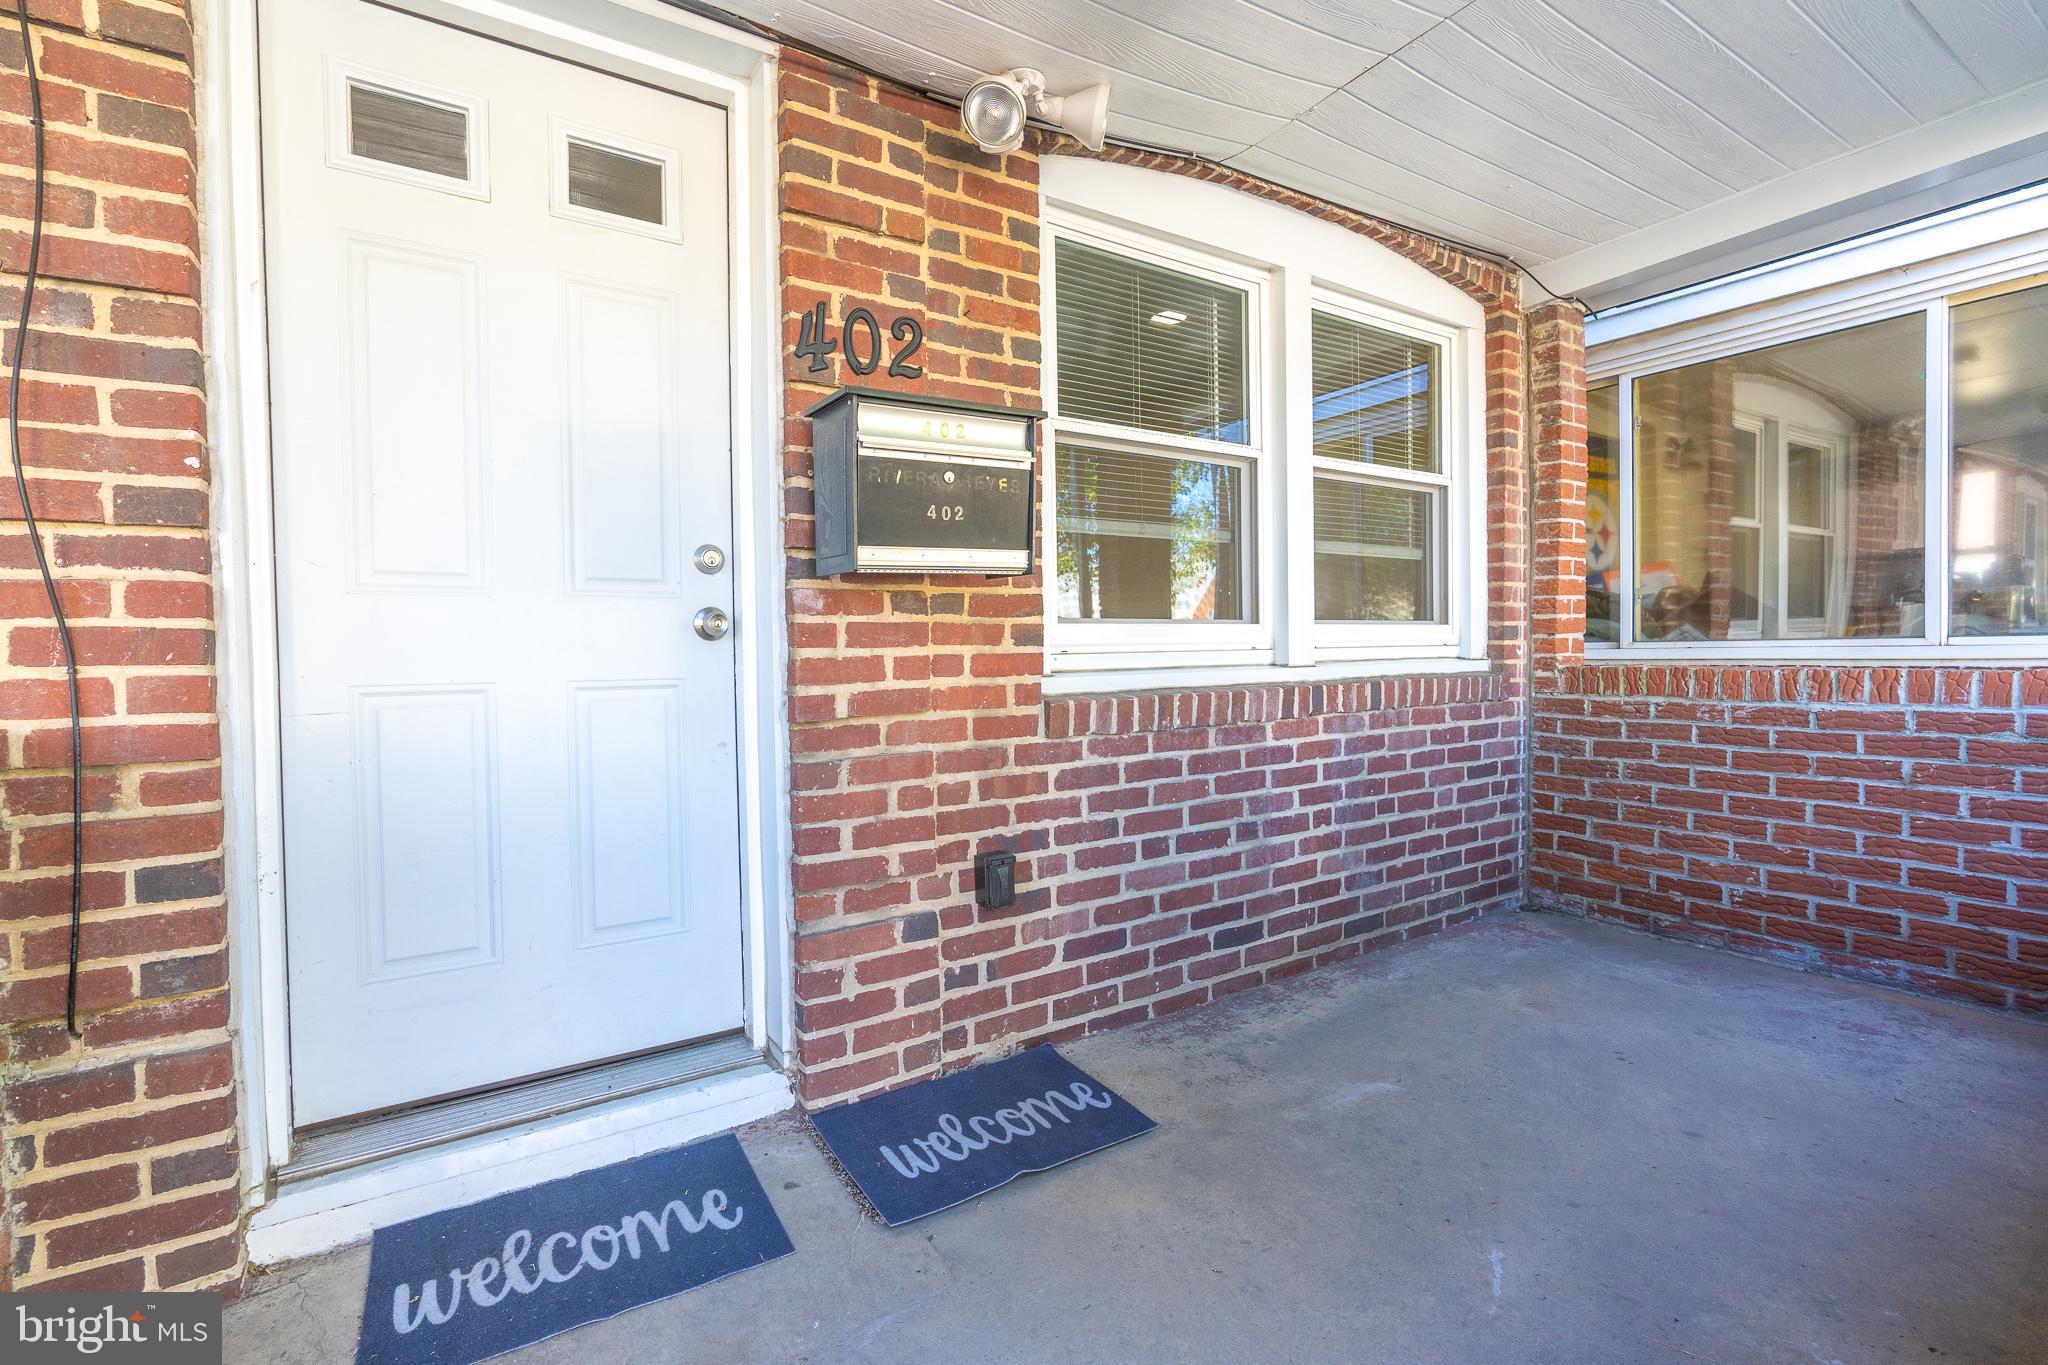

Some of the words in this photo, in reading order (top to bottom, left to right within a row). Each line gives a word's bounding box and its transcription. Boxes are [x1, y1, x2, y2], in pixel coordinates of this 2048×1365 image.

[794, 301, 924, 380] 402
[923, 420, 965, 439] 402
[927, 504, 964, 521] 402
[880, 1082, 1112, 1178] welcome
[393, 1189, 743, 1334] welcome
